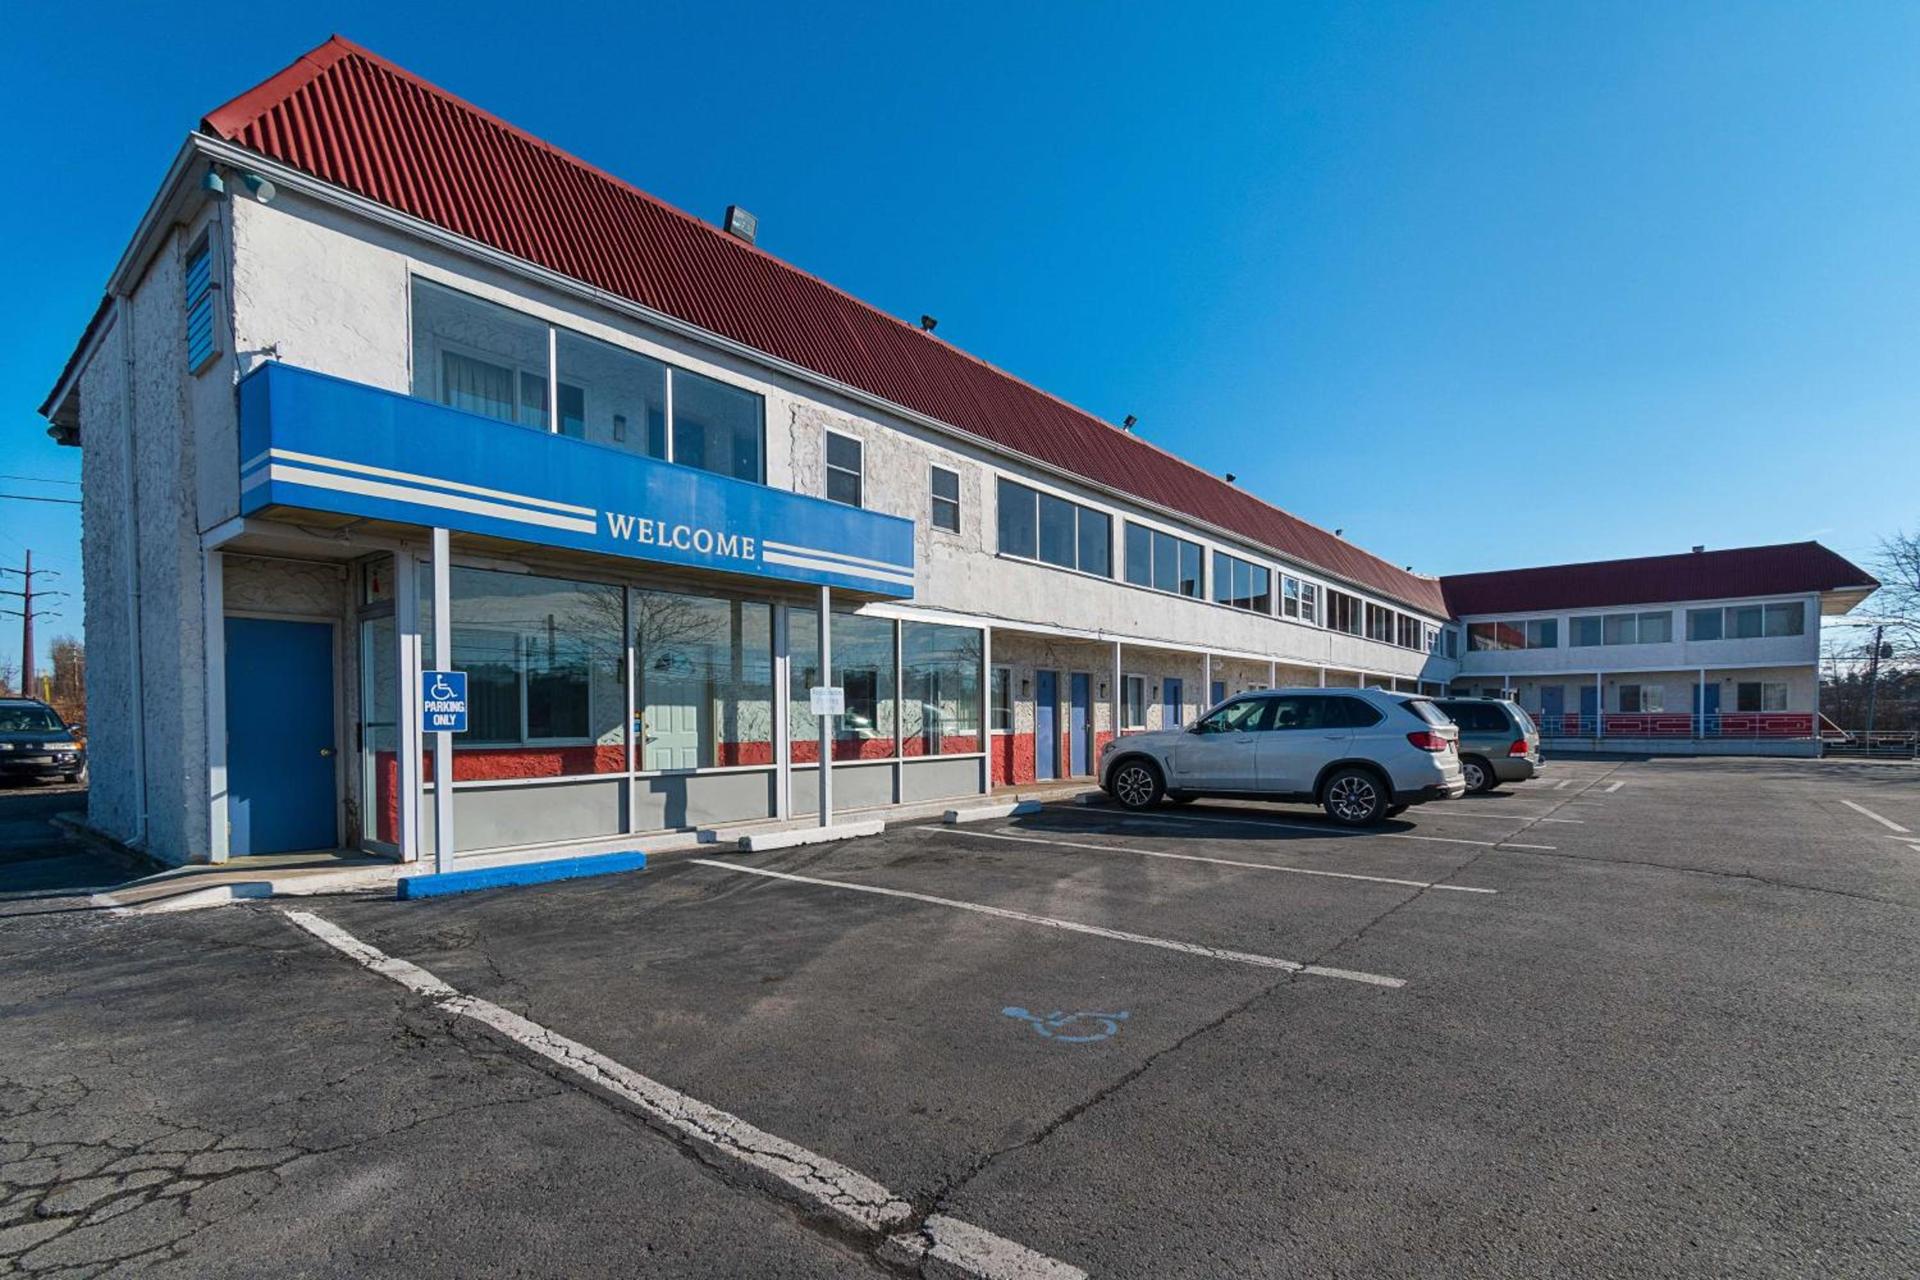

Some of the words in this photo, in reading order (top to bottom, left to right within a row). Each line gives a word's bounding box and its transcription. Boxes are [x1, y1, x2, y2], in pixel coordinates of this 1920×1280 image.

[605, 511, 755, 560] WELCOME
[424, 701, 465, 713] PARKING
[433, 714, 456, 726] ONLY
